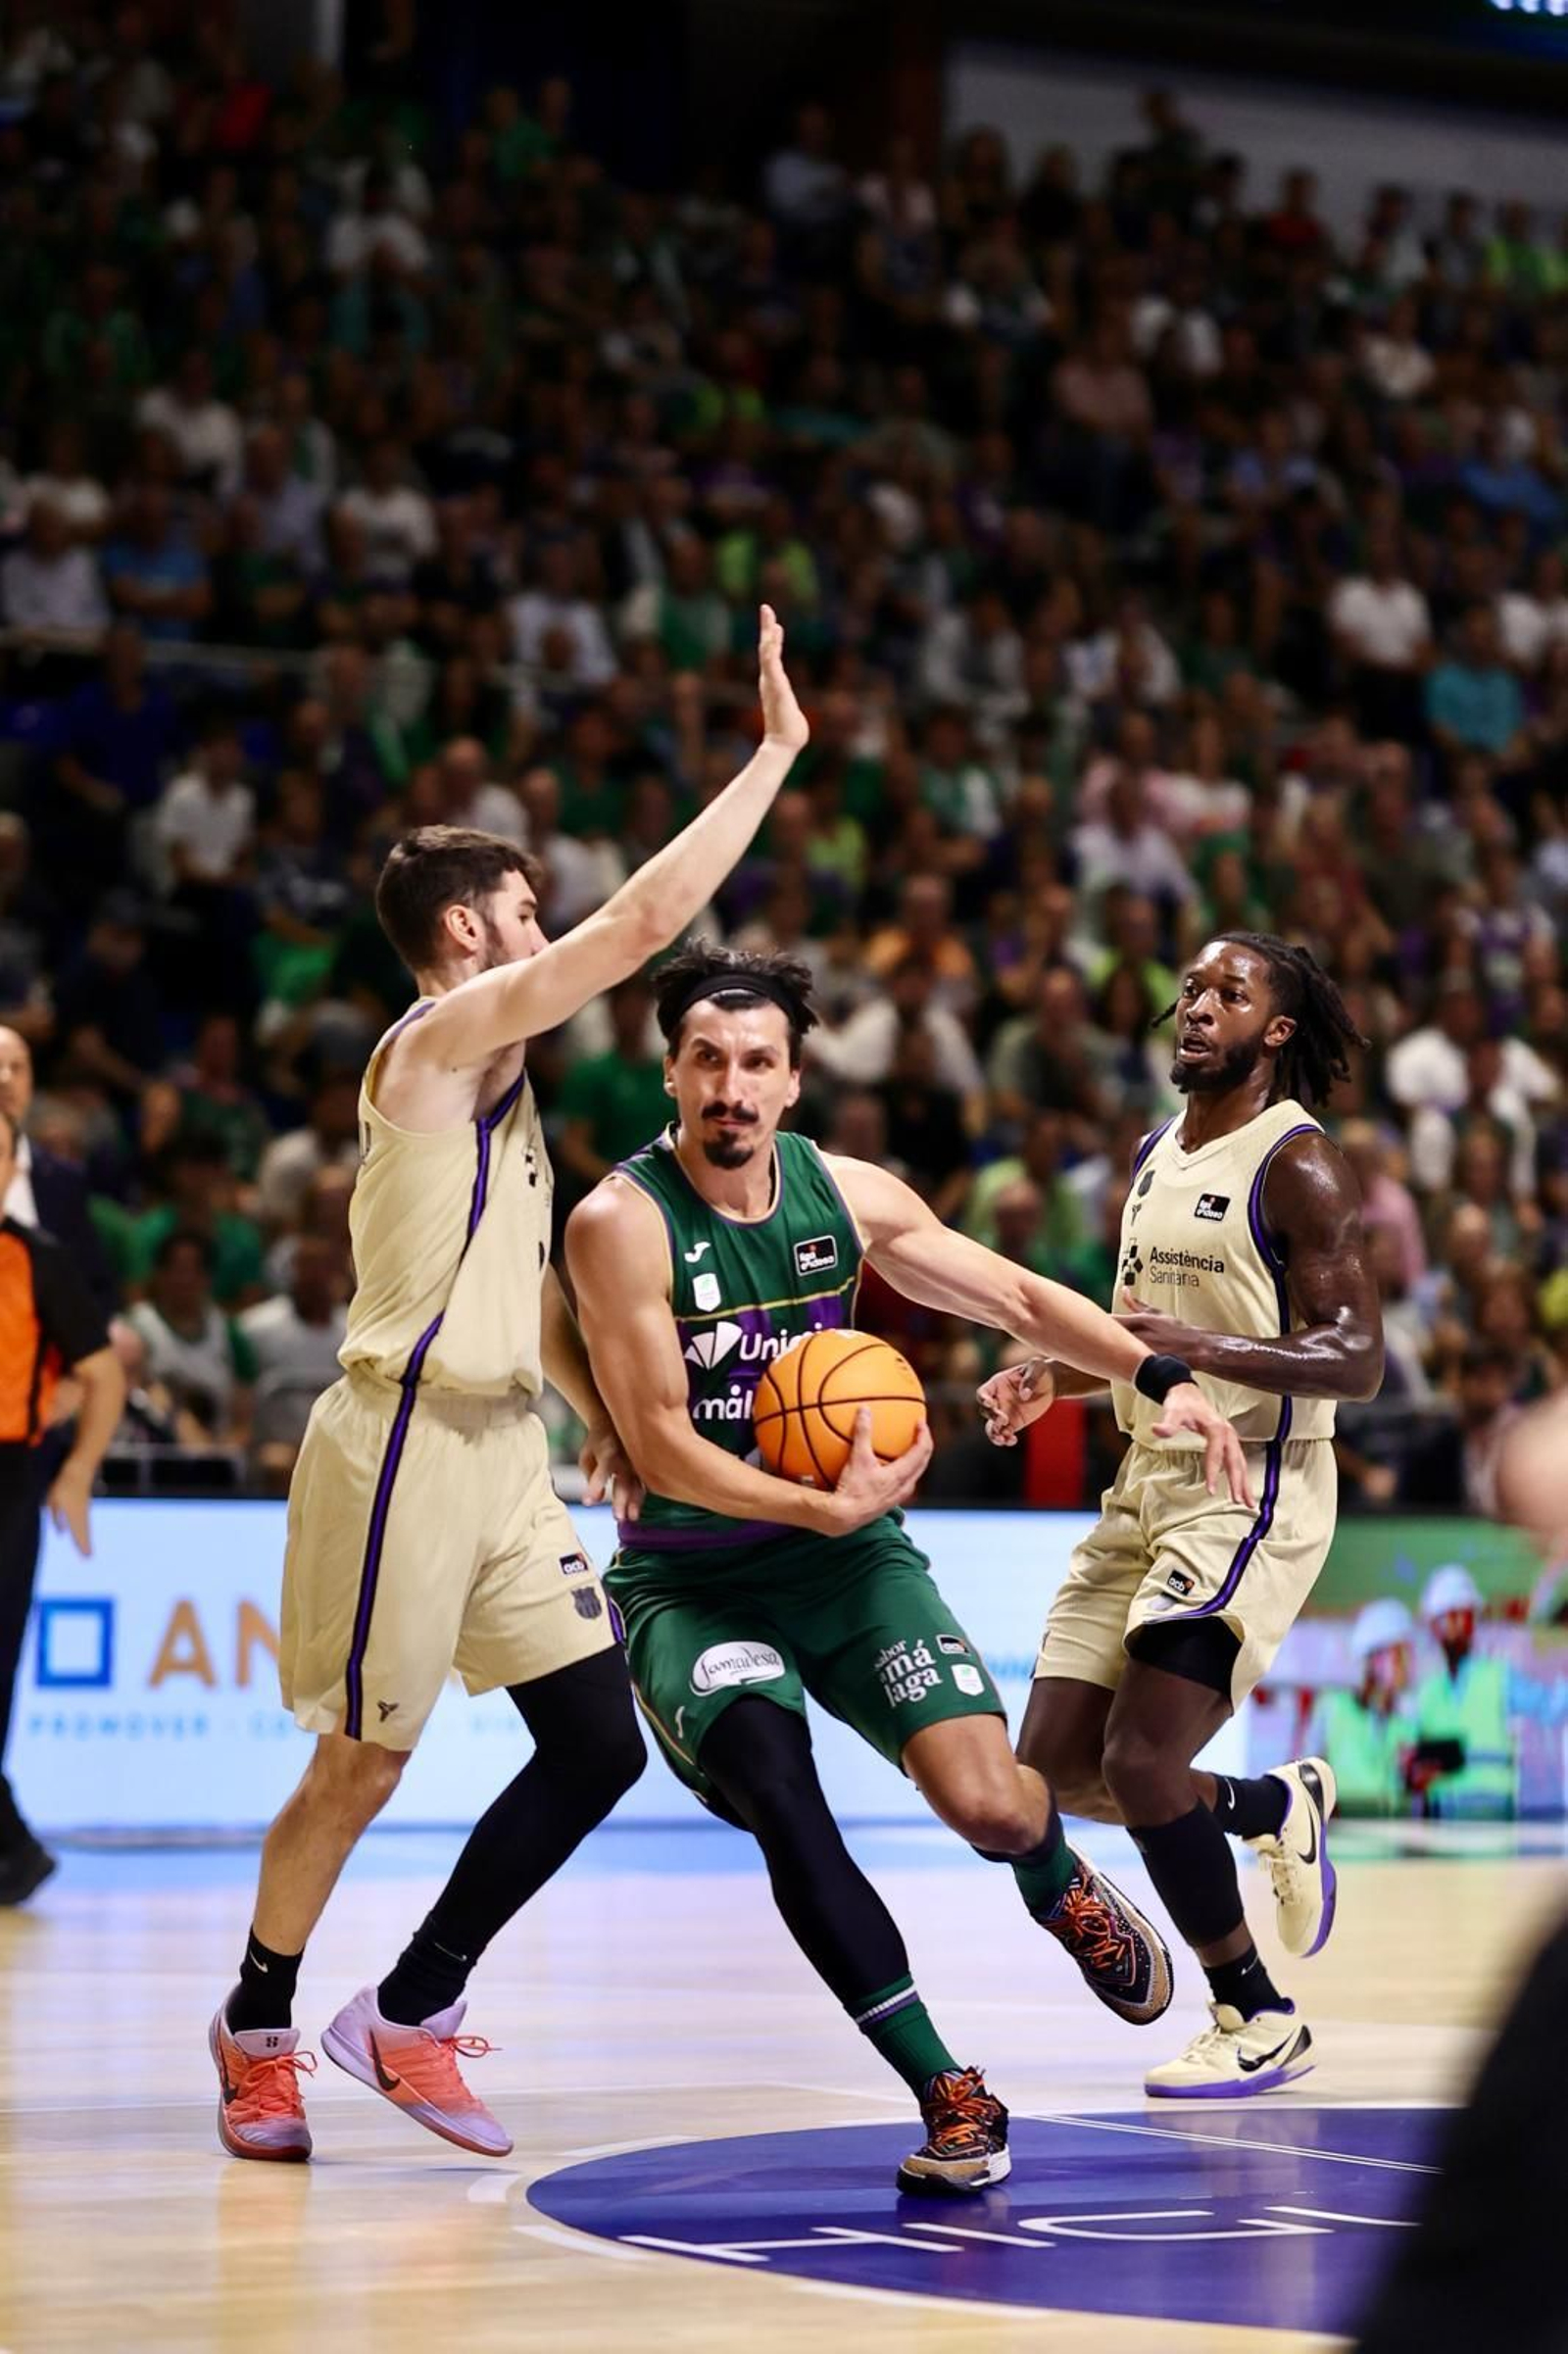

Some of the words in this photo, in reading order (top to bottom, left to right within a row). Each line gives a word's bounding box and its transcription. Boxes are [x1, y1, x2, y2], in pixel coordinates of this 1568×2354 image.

[1150, 1246, 1225, 1274] Assistència
[692, 1384, 754, 1420] mál
[147, 1598, 283, 1689] AN
[884, 1667, 944, 1708] laga
